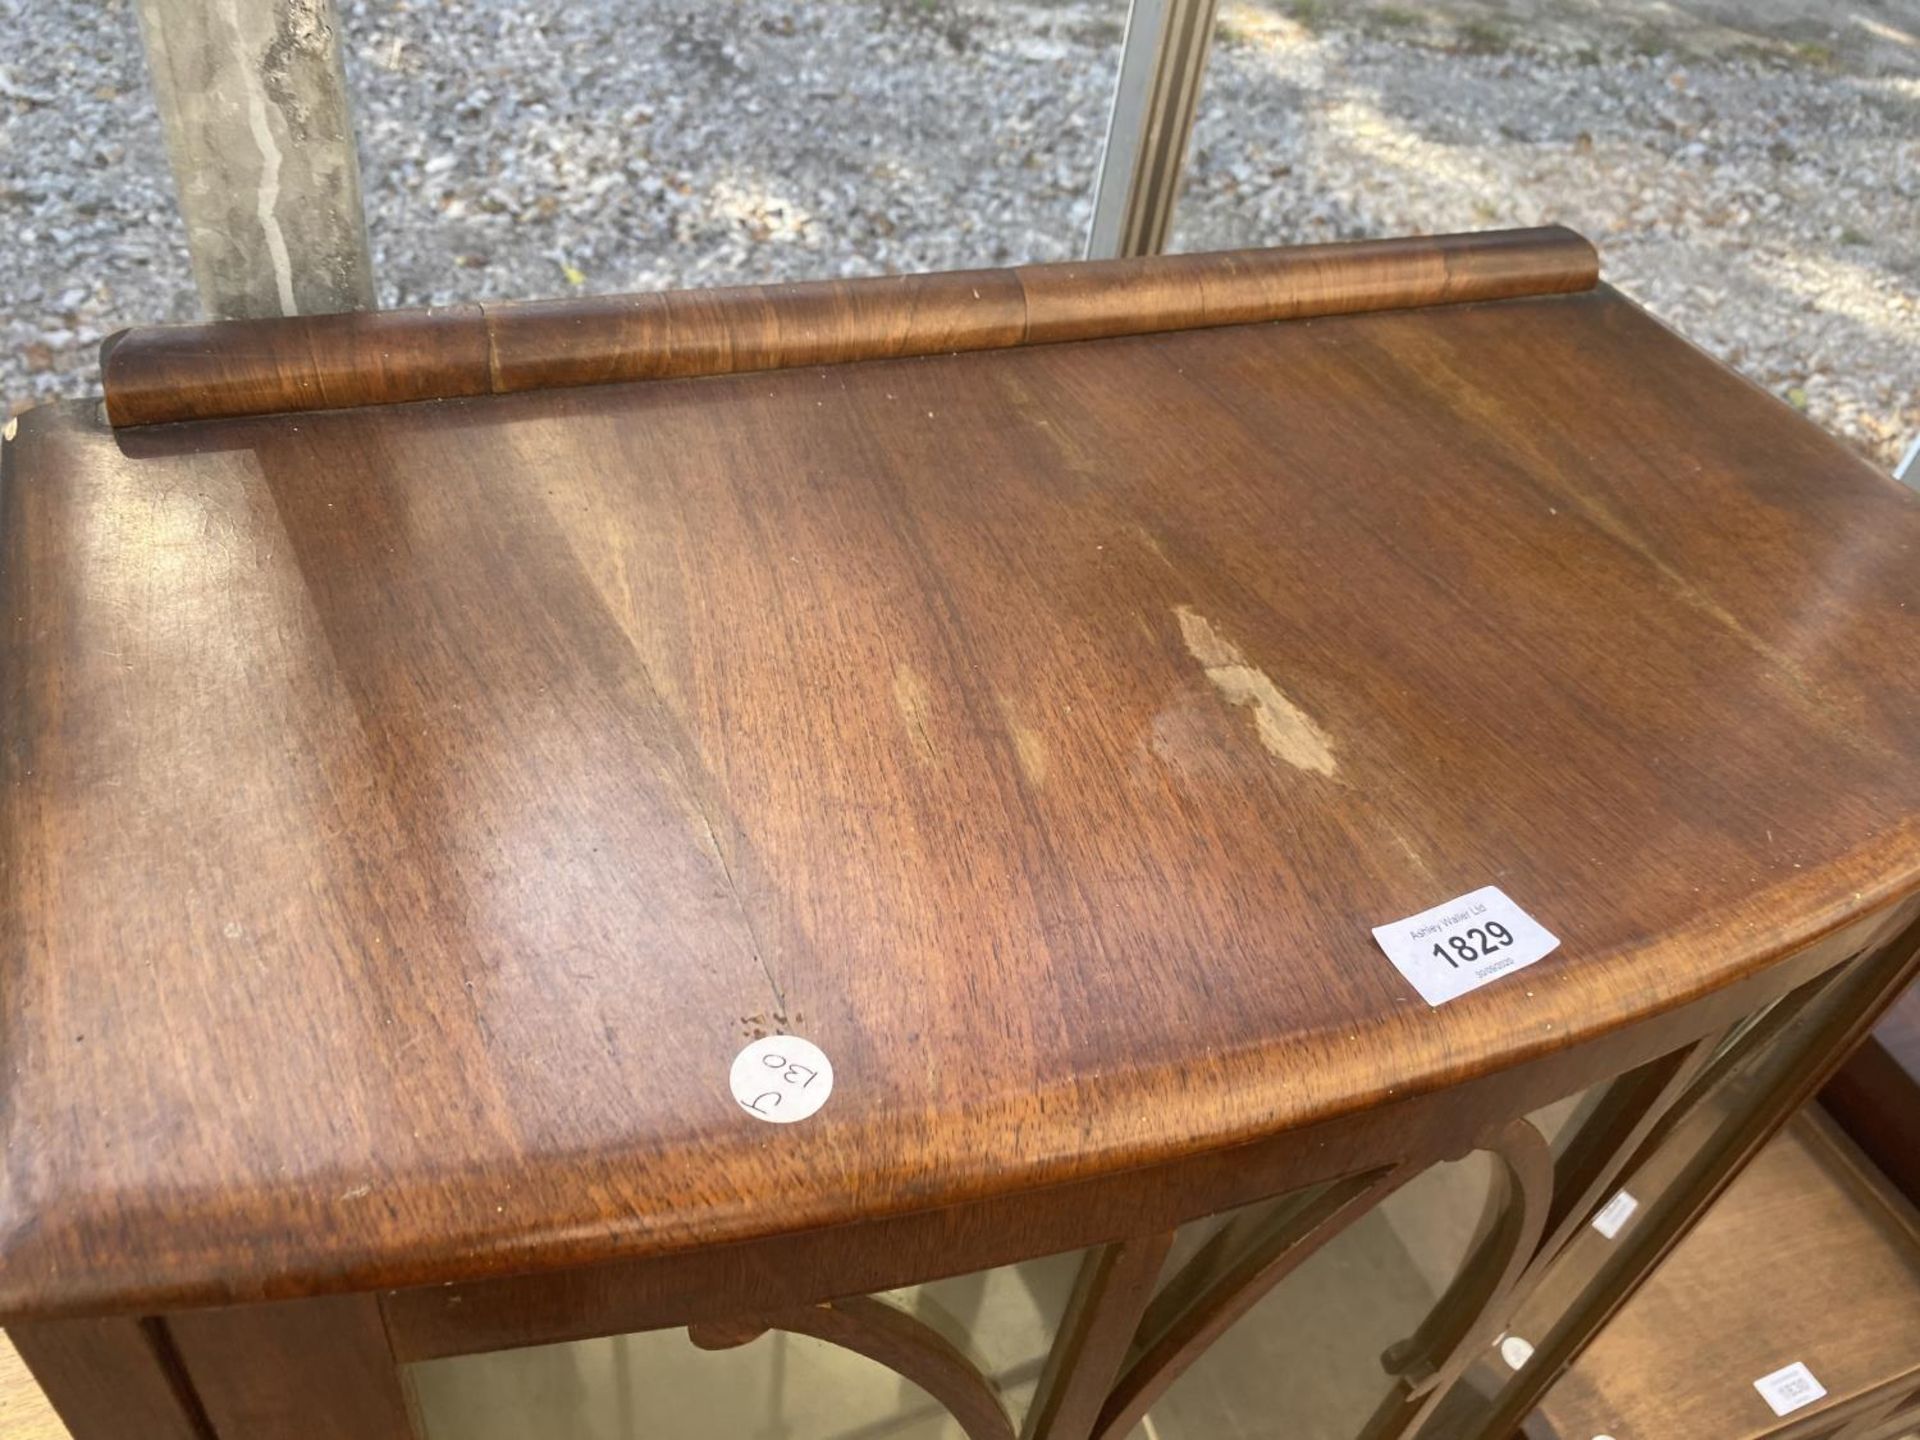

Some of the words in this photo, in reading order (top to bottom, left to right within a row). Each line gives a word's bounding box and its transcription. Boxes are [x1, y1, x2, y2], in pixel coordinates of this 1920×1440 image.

[1410, 924, 1442, 940] Ashley
[1470, 903, 1487, 916] Ltd
[1433, 921, 1514, 968] 1829
